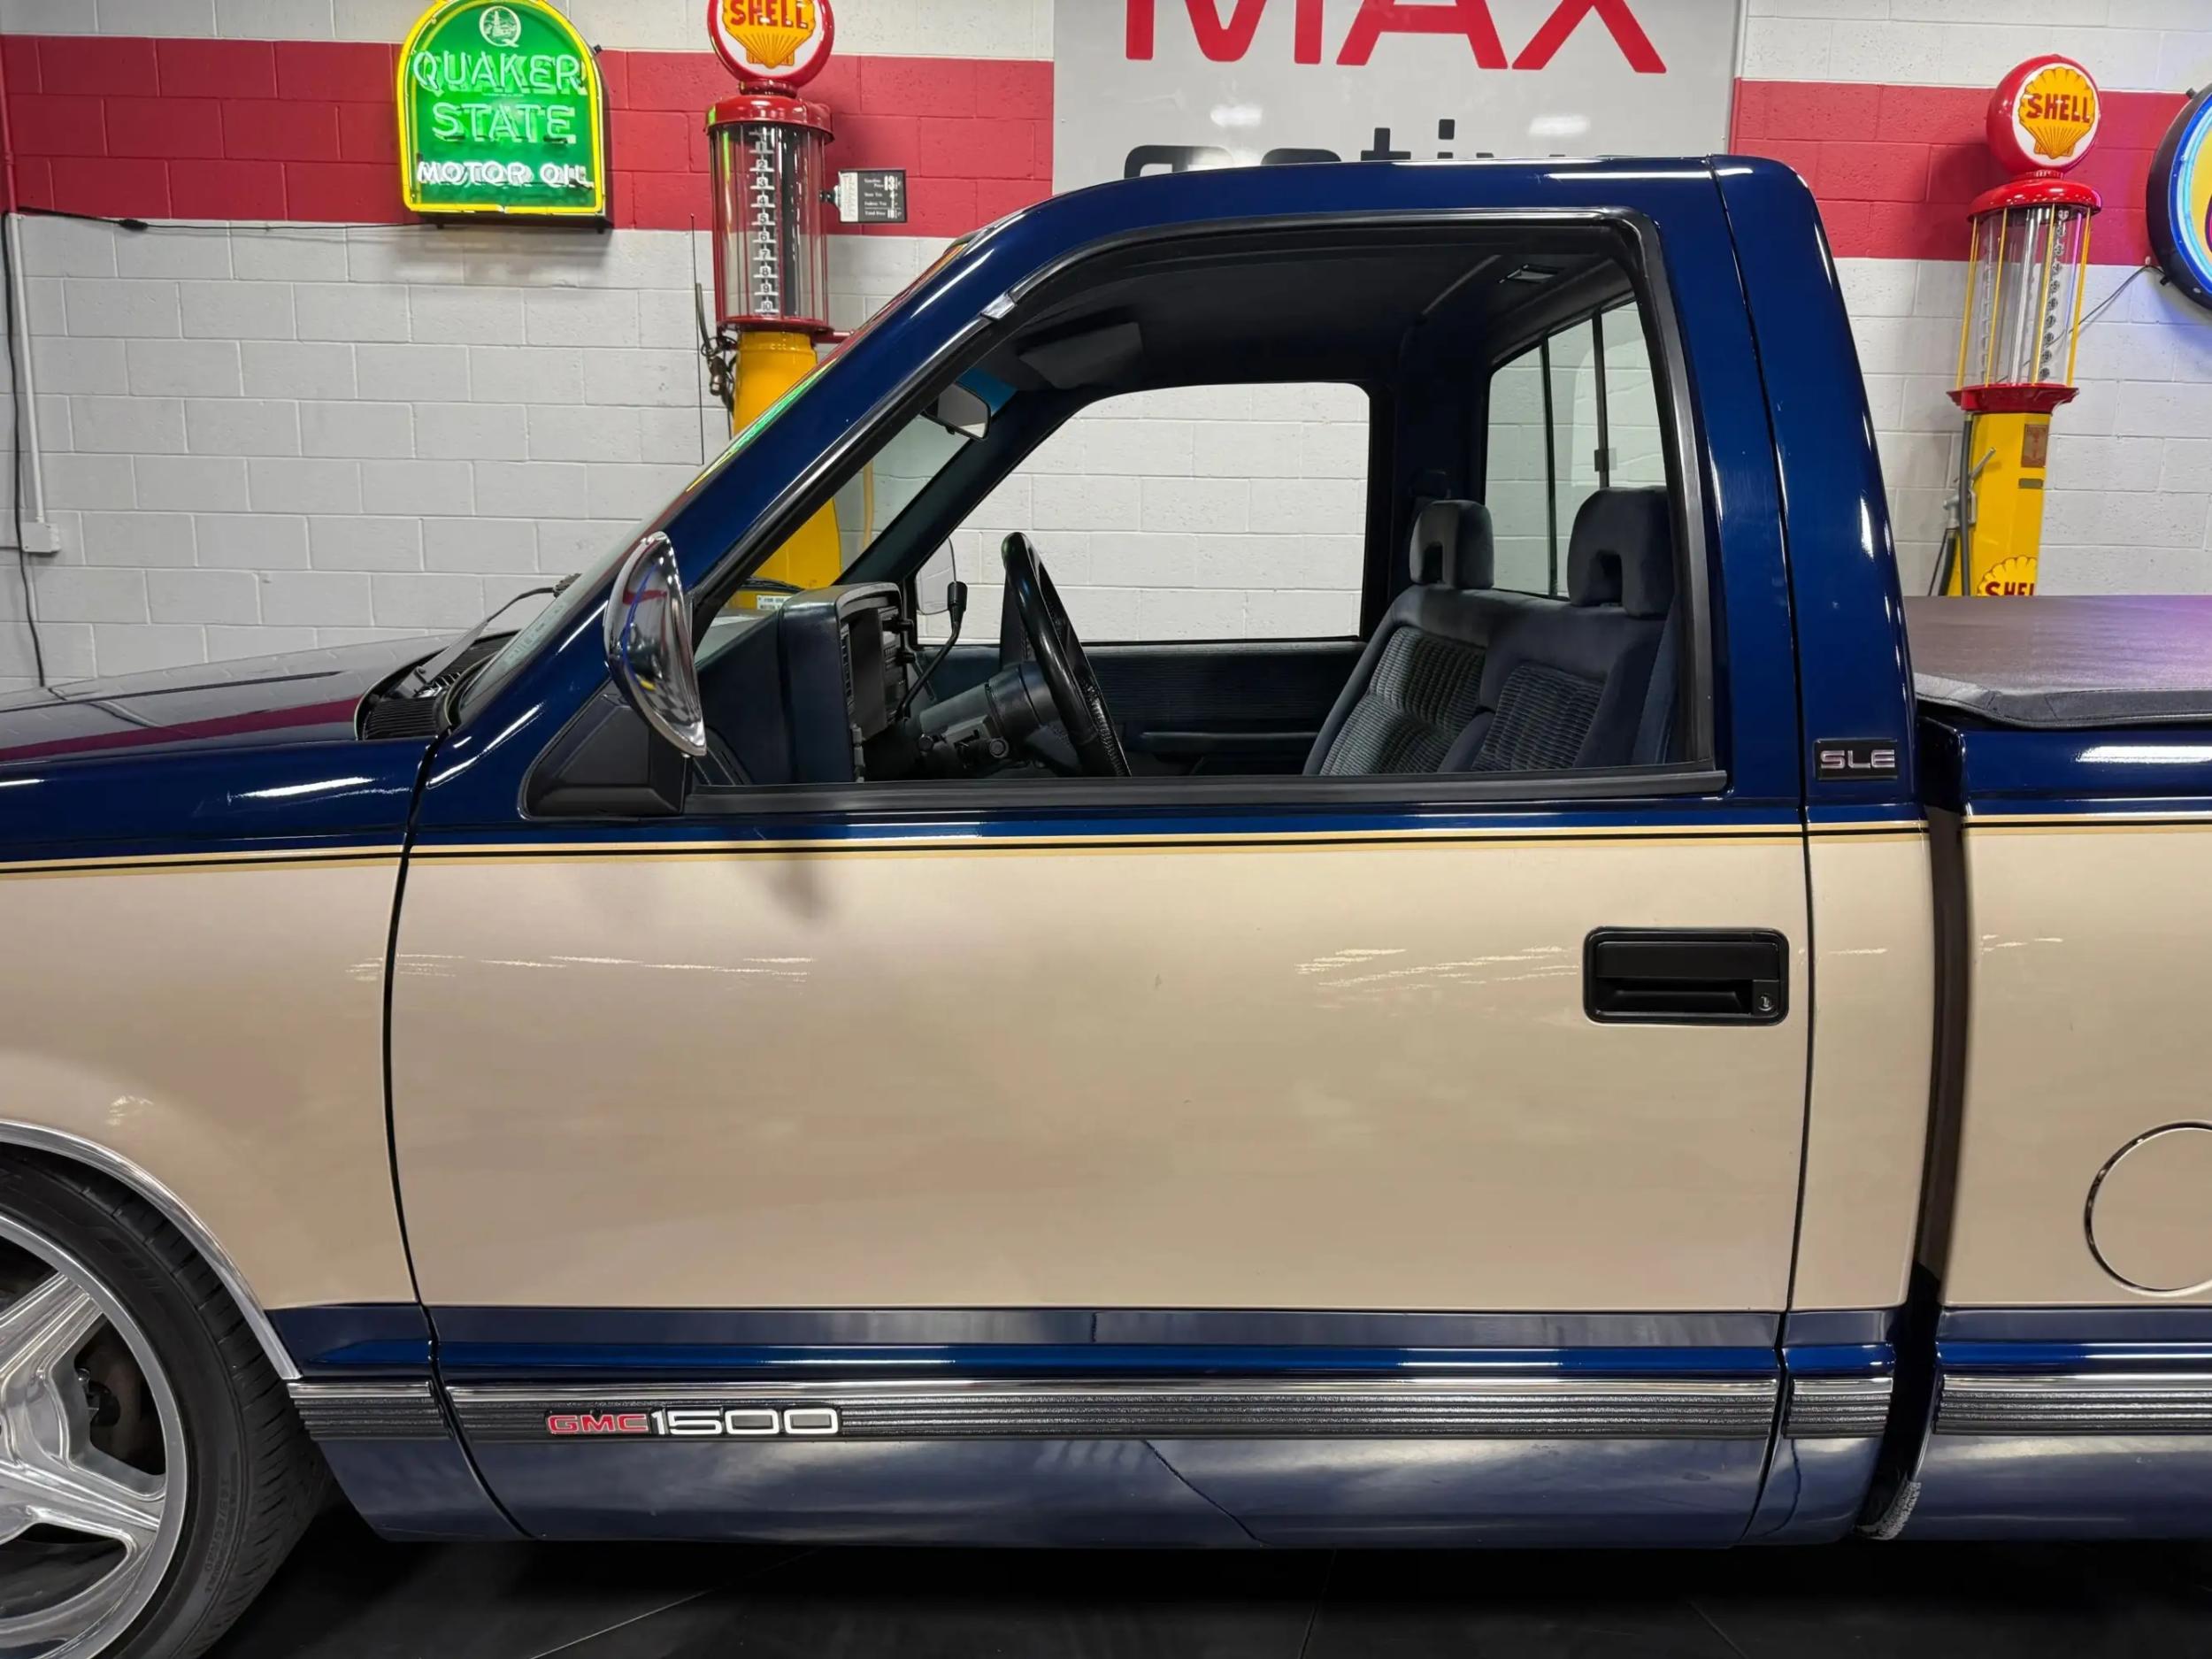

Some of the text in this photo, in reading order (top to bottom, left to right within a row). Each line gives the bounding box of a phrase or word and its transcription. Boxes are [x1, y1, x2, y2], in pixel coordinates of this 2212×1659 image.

[730, 0, 809, 29] SHELL
[413, 50, 588, 96] QUAKER
[2026, 92, 2091, 124] SHELL
[432, 102, 576, 143] STATE
[758, 160, 765, 170] 2
[418, 160, 595, 188] MOTOR OIL
[759, 178, 765, 187] 3
[759, 196, 765, 205] 4
[760, 214, 766, 223] 5
[761, 232, 767, 241] 6
[762, 250, 768, 259] 7
[762, 267, 769, 276] 8
[763, 302, 772, 311] 10
[1820, 749, 1895, 769] SLE
[547, 1409, 839, 1435] GMC 1500
